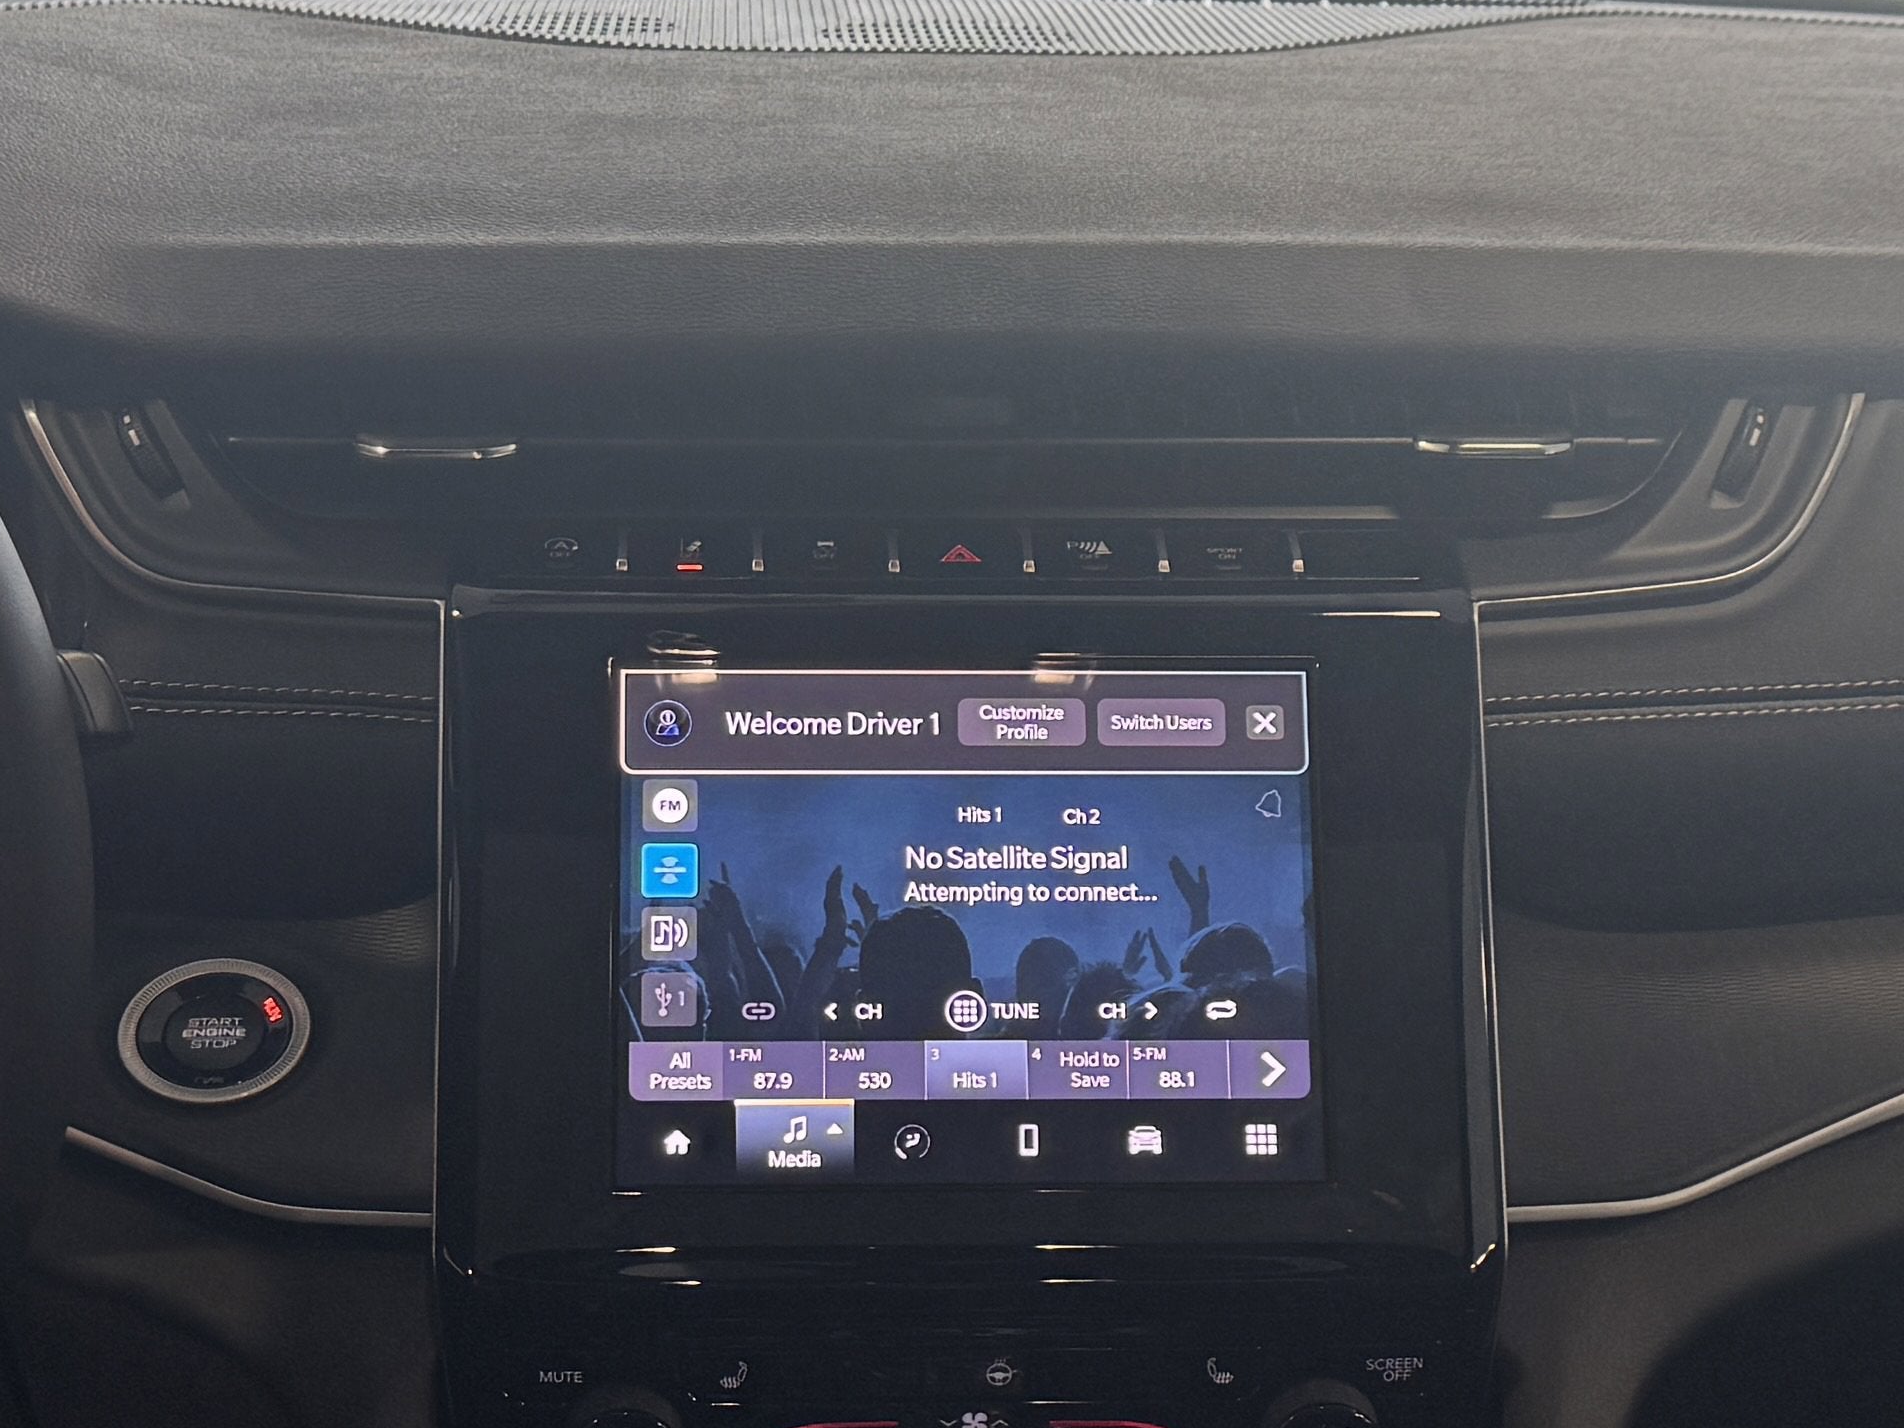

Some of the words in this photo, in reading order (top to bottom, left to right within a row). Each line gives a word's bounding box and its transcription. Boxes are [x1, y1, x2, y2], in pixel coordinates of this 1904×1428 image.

[979, 704, 1064, 721] Customize
[725, 711, 842, 735] Welcome
[847, 711, 923, 735] Driver
[929, 712, 941, 735] 1
[1111, 714, 1164, 731] Switch
[1166, 715, 1213, 731] Users
[996, 724, 1048, 740] Profile
[659, 800, 681, 811] FM
[957, 807, 991, 823] Hits
[994, 806, 1003, 823] 1
[1062, 808, 1086, 825] Ch
[1088, 809, 1101, 824] 2
[905, 845, 944, 870] No
[947, 845, 1047, 870] Satellite
[1050, 845, 1129, 875] Signal
[904, 880, 1024, 907] Attempting
[1027, 883, 1051, 902] to
[1054, 883, 1159, 903] connect...
[854, 1003, 884, 1021] CH
[990, 1002, 1040, 1020] TUNE
[1098, 1003, 1127, 1020] CH
[187, 1017, 244, 1027] START
[182, 1028, 246, 1038] ENGINE
[191, 1039, 237, 1049] STOP
[670, 1052, 691, 1069] All
[729, 1048, 762, 1062] 1-FM
[829, 1048, 865, 1062] 2-AM
[930, 1048, 940, 1061] 3
[1031, 1048, 1042, 1061] 4
[1059, 1051, 1099, 1068] Hold
[1102, 1053, 1120, 1068] to
[1132, 1047, 1167, 1061] 5-FM
[649, 1074, 712, 1090] Presets
[753, 1072, 793, 1089] 87.9
[858, 1072, 892, 1089] 530
[953, 1072, 987, 1089] Hits
[990, 1072, 998, 1088] 1
[1071, 1072, 1110, 1088] Save
[1159, 1071, 1195, 1088] 88.1
[768, 1150, 822, 1168] Media
[1366, 1357, 1423, 1370] SCREEN
[539, 1371, 583, 1383] MUTE
[1383, 1370, 1412, 1382] OFF
